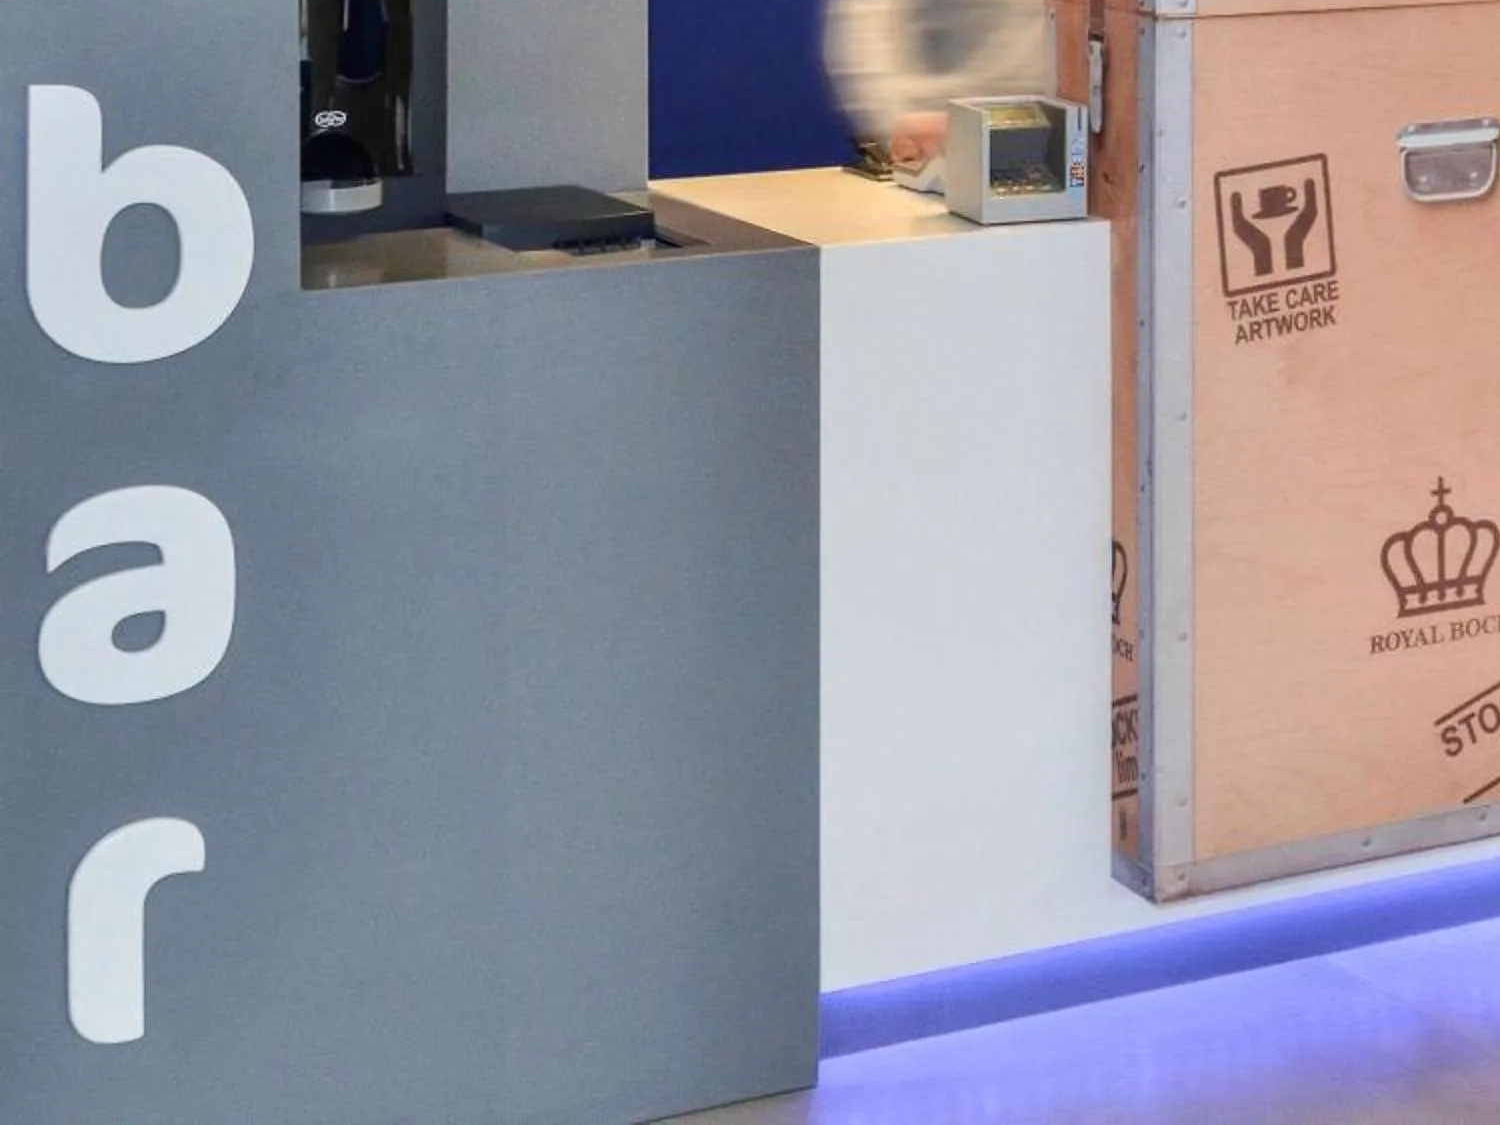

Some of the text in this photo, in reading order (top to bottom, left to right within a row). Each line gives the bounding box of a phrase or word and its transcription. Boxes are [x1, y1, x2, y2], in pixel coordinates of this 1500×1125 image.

[1227, 280, 1340, 321] TAKE CARE
[1234, 305, 1337, 345] ARTWORK
[26, 83, 255, 1045] bar
[1370, 625, 1445, 654] ROYAL
